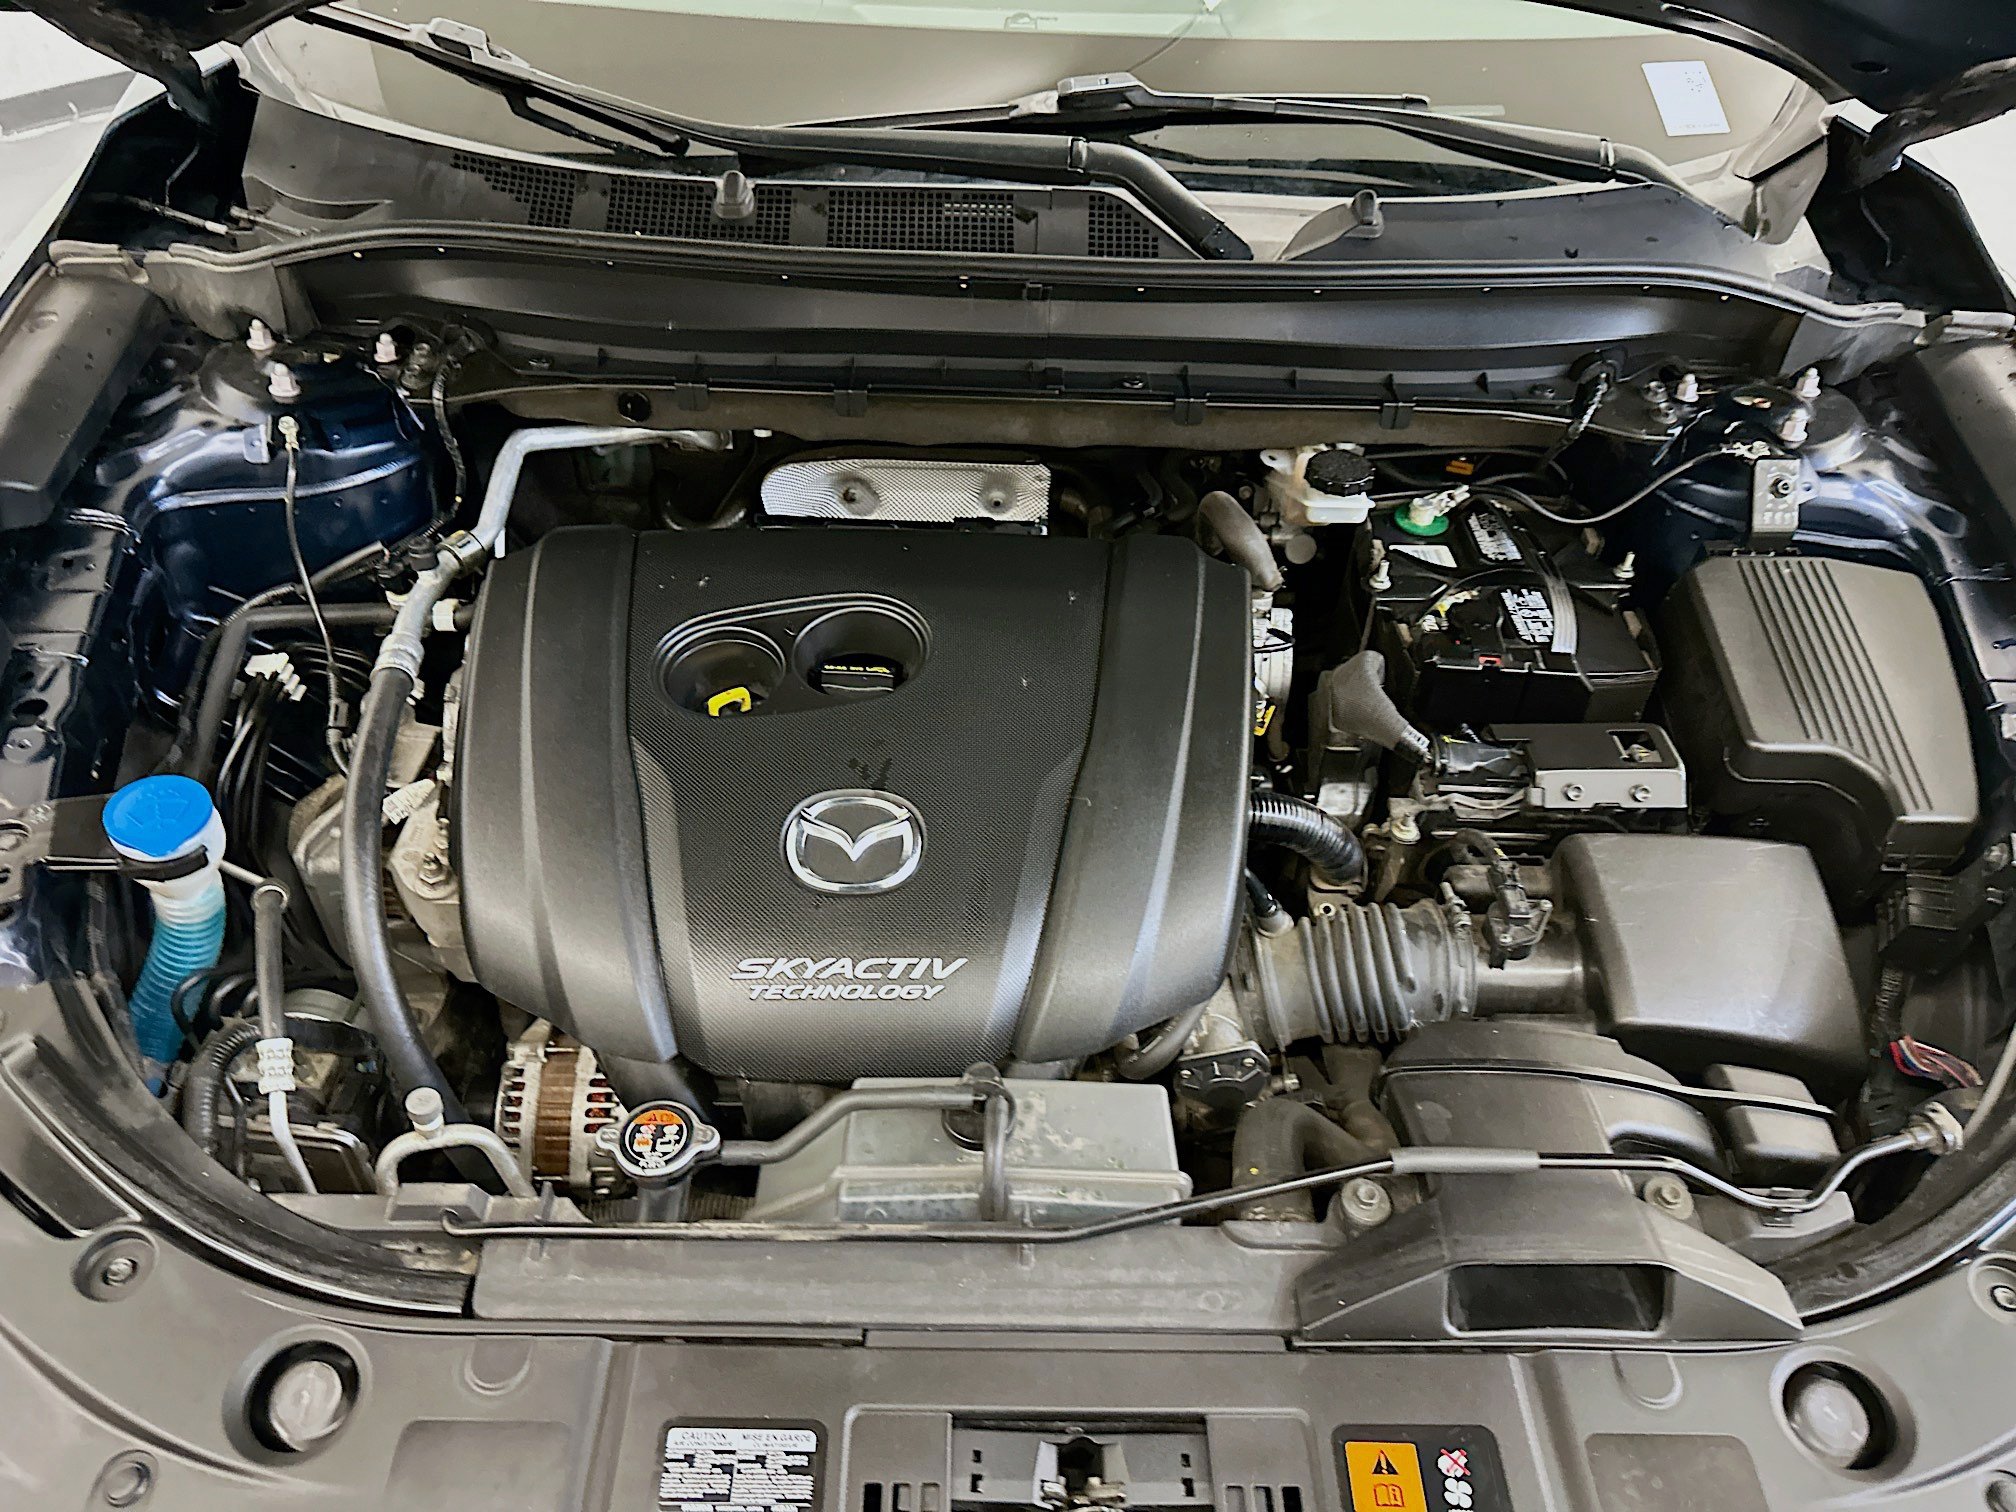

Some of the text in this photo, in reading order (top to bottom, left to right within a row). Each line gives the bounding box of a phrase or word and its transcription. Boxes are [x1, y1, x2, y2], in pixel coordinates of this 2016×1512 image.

[729, 956, 969, 981] SKYACTIV
[749, 984, 946, 1001] TECHNOLOGY
[681, 1431, 727, 1441] CAUTION
